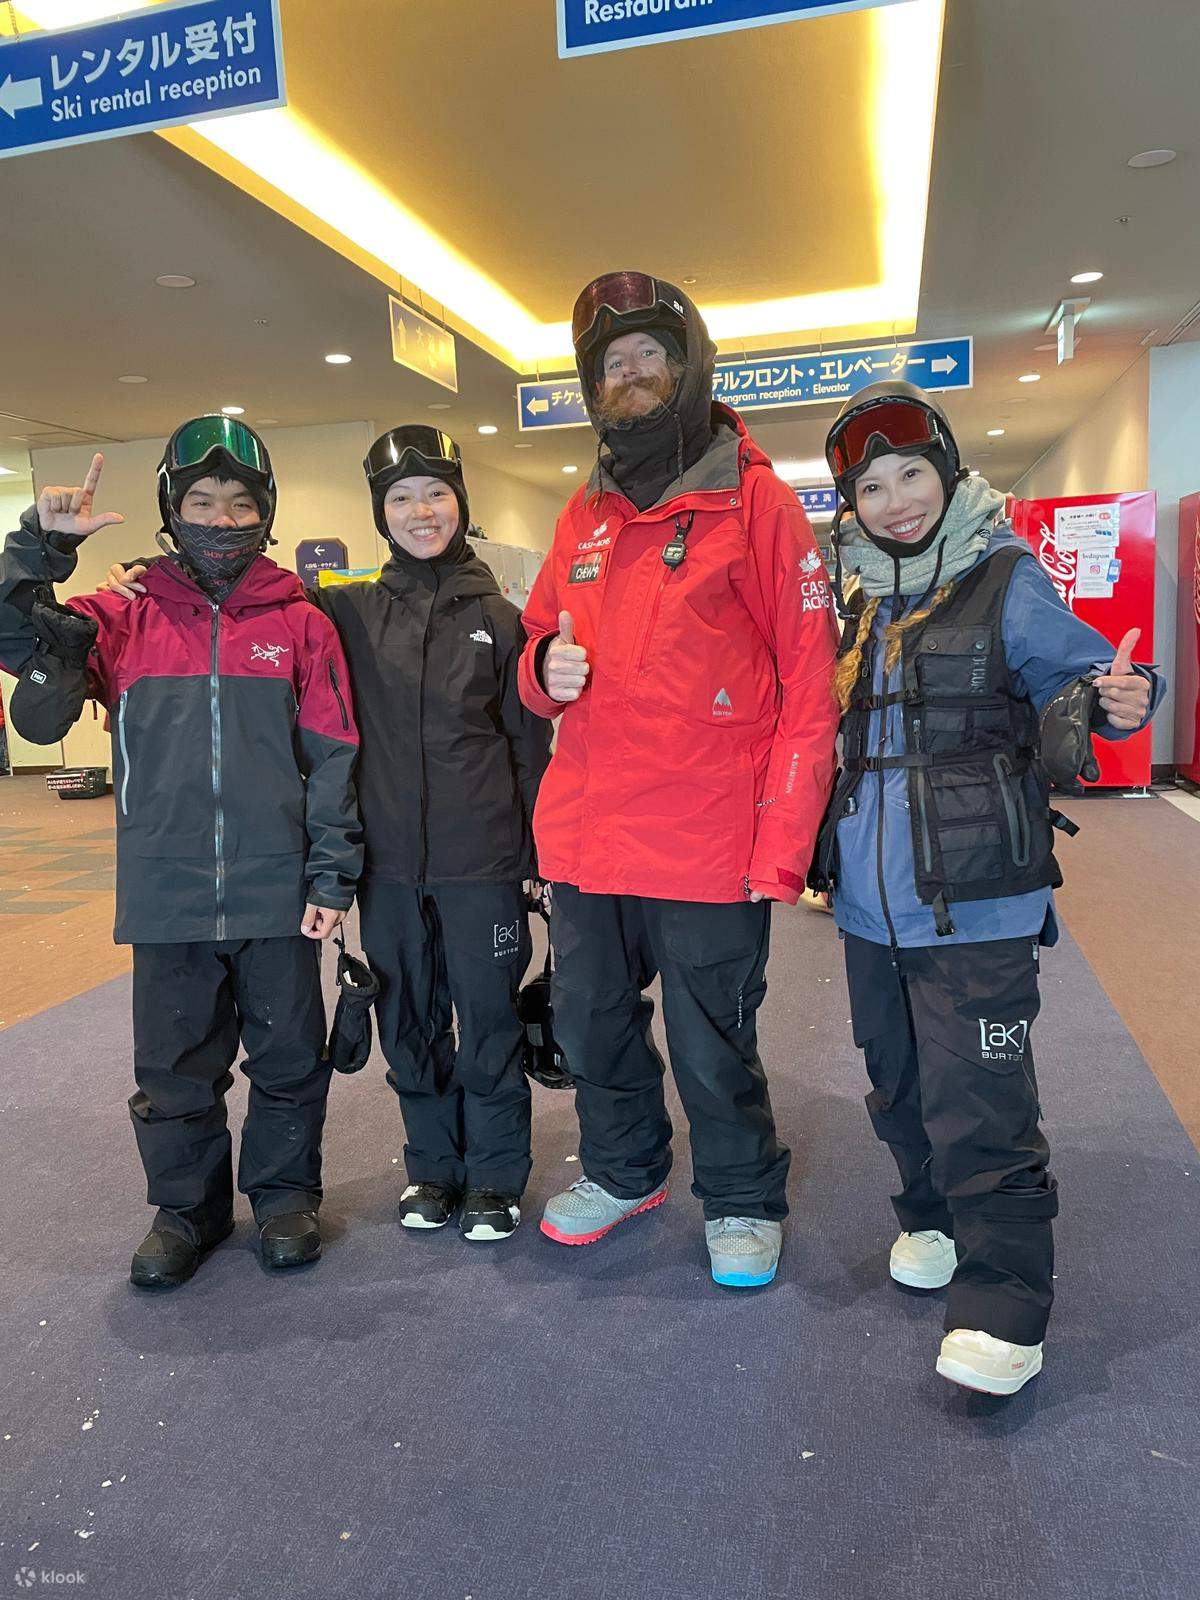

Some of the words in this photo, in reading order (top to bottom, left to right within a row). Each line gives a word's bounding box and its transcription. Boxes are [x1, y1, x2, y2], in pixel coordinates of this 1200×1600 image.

[51, 12, 257, 90] レンタル受付
[51, 95, 83, 122] Ski
[90, 80, 151, 115] rental
[160, 65, 262, 101] reception
[716, 393, 757, 404] Tangram
[759, 386, 802, 400] reception
[813, 382, 851, 394] Elevator
